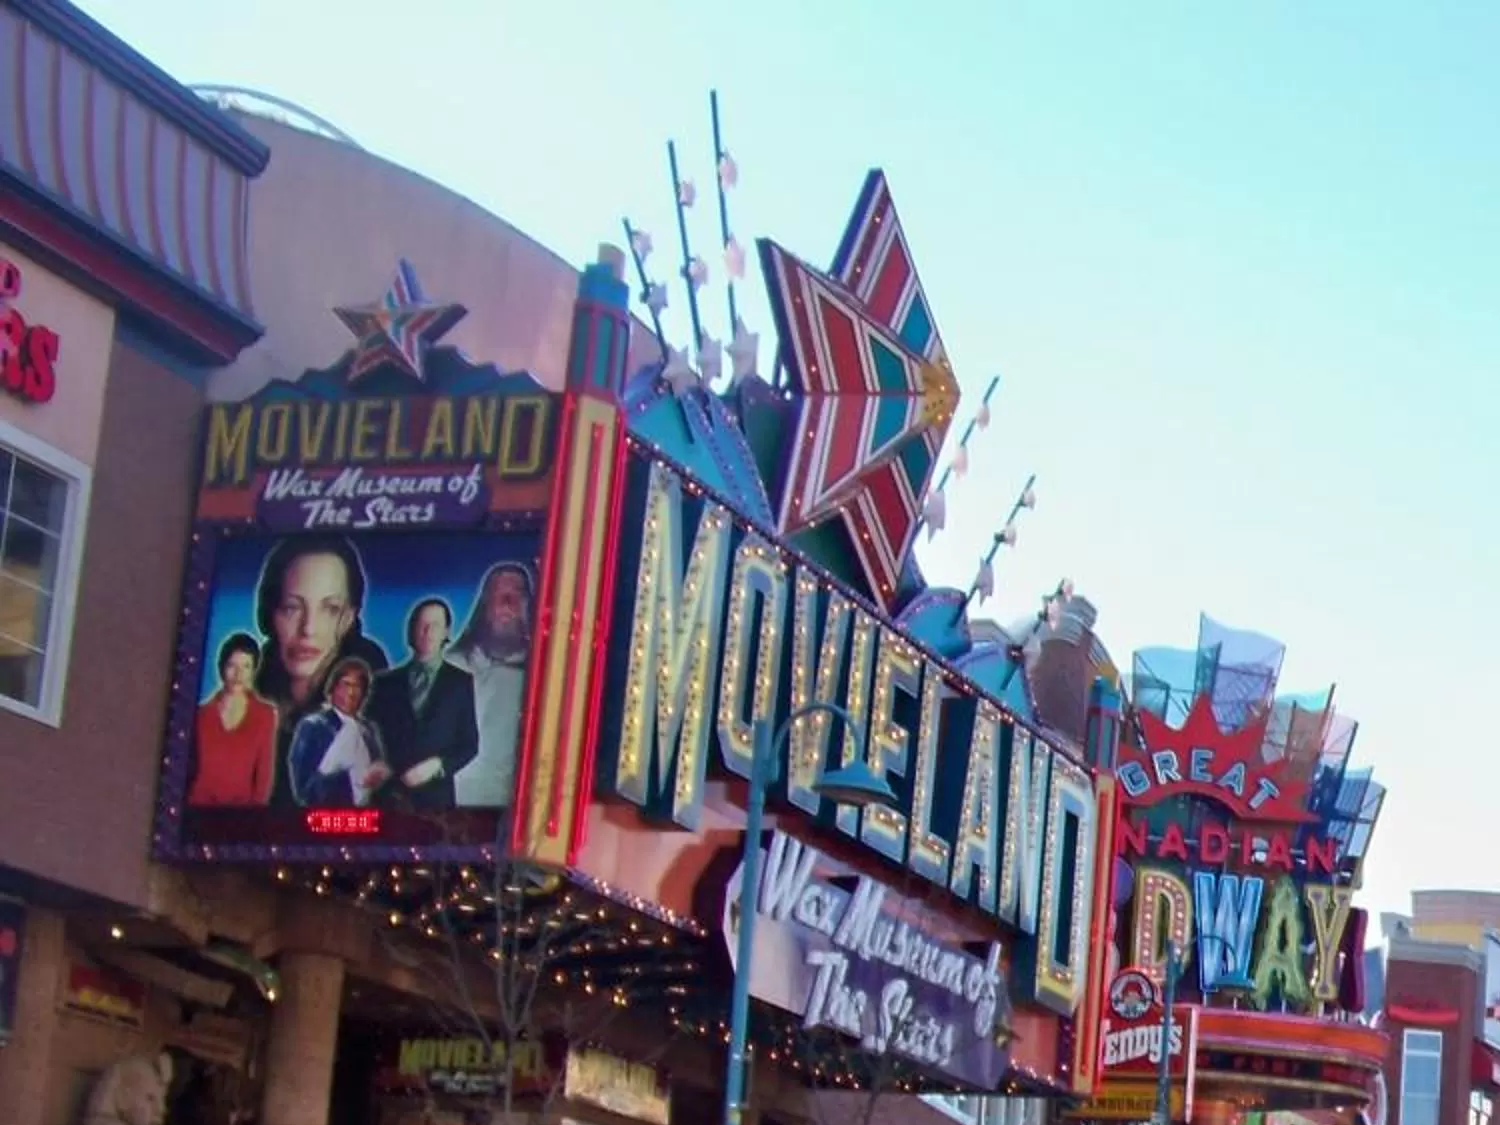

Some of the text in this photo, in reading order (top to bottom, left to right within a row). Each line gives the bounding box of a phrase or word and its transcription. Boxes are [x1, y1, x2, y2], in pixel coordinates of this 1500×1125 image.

[204, 394, 549, 484] MOVIELAND
[263, 463, 482, 504] Wax Museum of
[303, 497, 436, 528] The Stars
[615, 460, 1098, 1014] MOVIELAND
[1116, 747, 1281, 810] GREAT
[757, 828, 1002, 1038] Wax Museum of
[800, 951, 869, 1038] The
